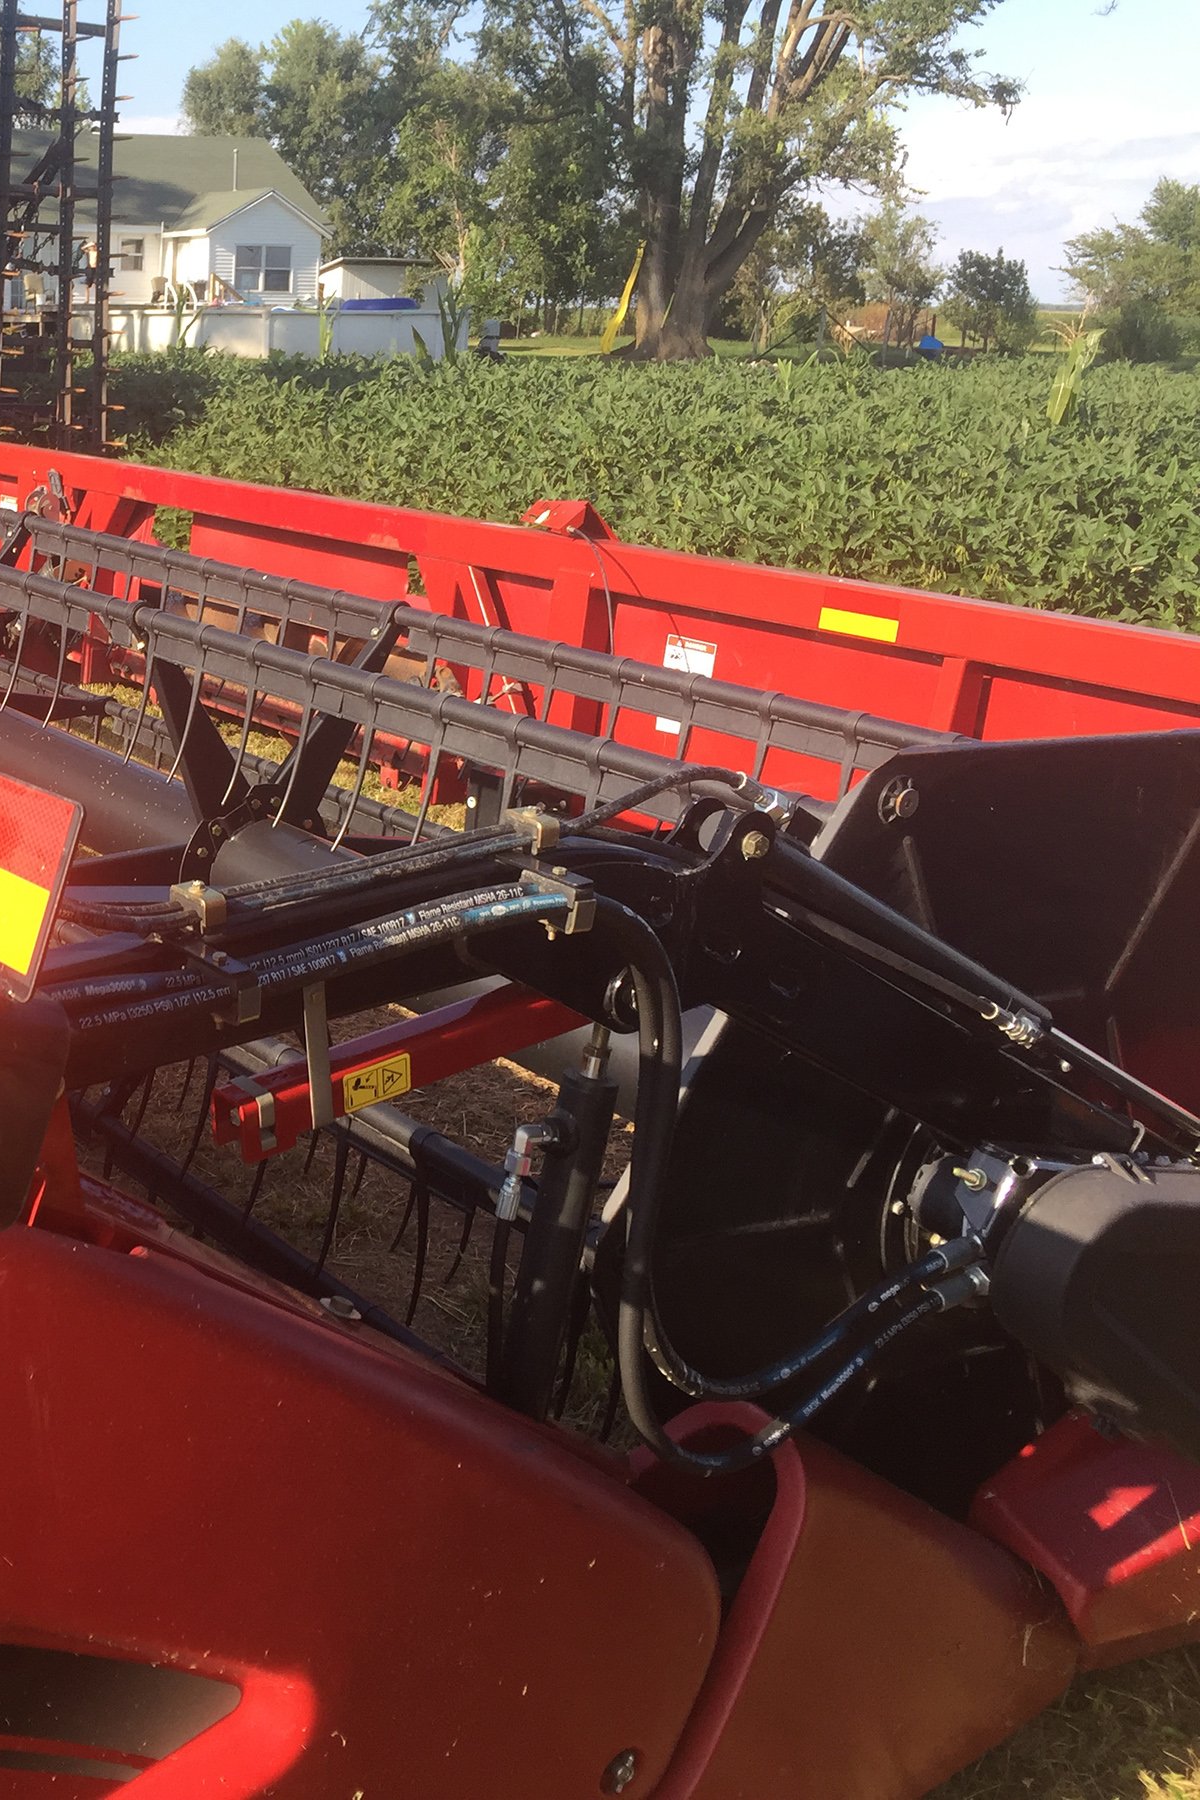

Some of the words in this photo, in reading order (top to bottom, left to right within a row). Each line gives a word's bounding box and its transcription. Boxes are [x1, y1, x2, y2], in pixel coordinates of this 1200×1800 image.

[341, 933, 356, 946] R17
[361, 926, 377, 938] SAE
[377, 917, 405, 934] 100R17
[418, 907, 441, 921] Flame
[441, 897, 474, 914] Resistant
[473, 891, 497, 905] MSHA
[496, 887, 524, 901] 2G-11C
[79, 1015, 102, 1030] 22.5
[103, 1010, 127, 1023] MPa
[271, 969, 286, 982] R17
[291, 963, 308, 977] SAE
[307, 954, 336, 971] 100R17
[349, 943, 374, 957] Flame
[373, 930, 408, 950] Resistant
[406, 925, 431, 941] MSHA
[430, 916, 460, 933] 2G-11C
